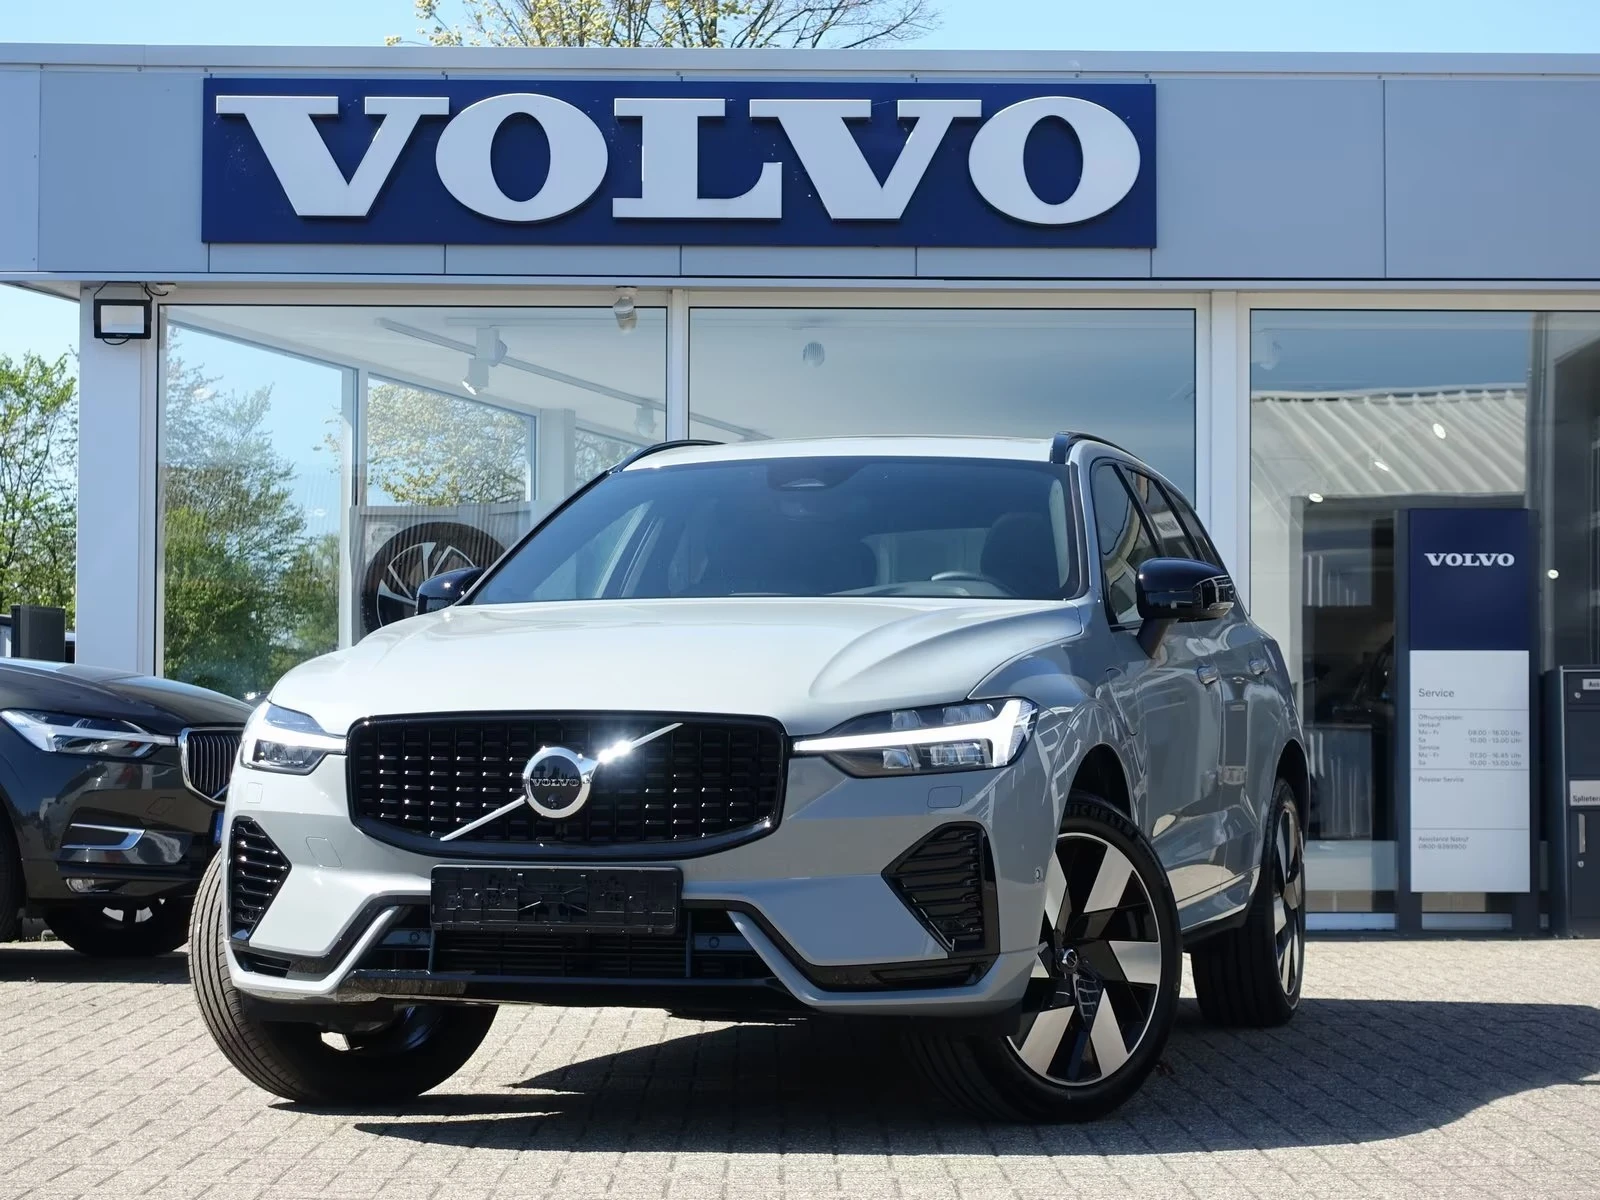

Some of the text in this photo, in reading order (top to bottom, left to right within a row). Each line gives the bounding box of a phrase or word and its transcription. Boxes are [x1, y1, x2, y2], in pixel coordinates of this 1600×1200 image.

[216, 93, 1140, 224] VOLVO
[1424, 553, 1515, 566] VOLVO
[1418, 688, 1455, 698] Service
[530, 778, 580, 787] VOLVO
